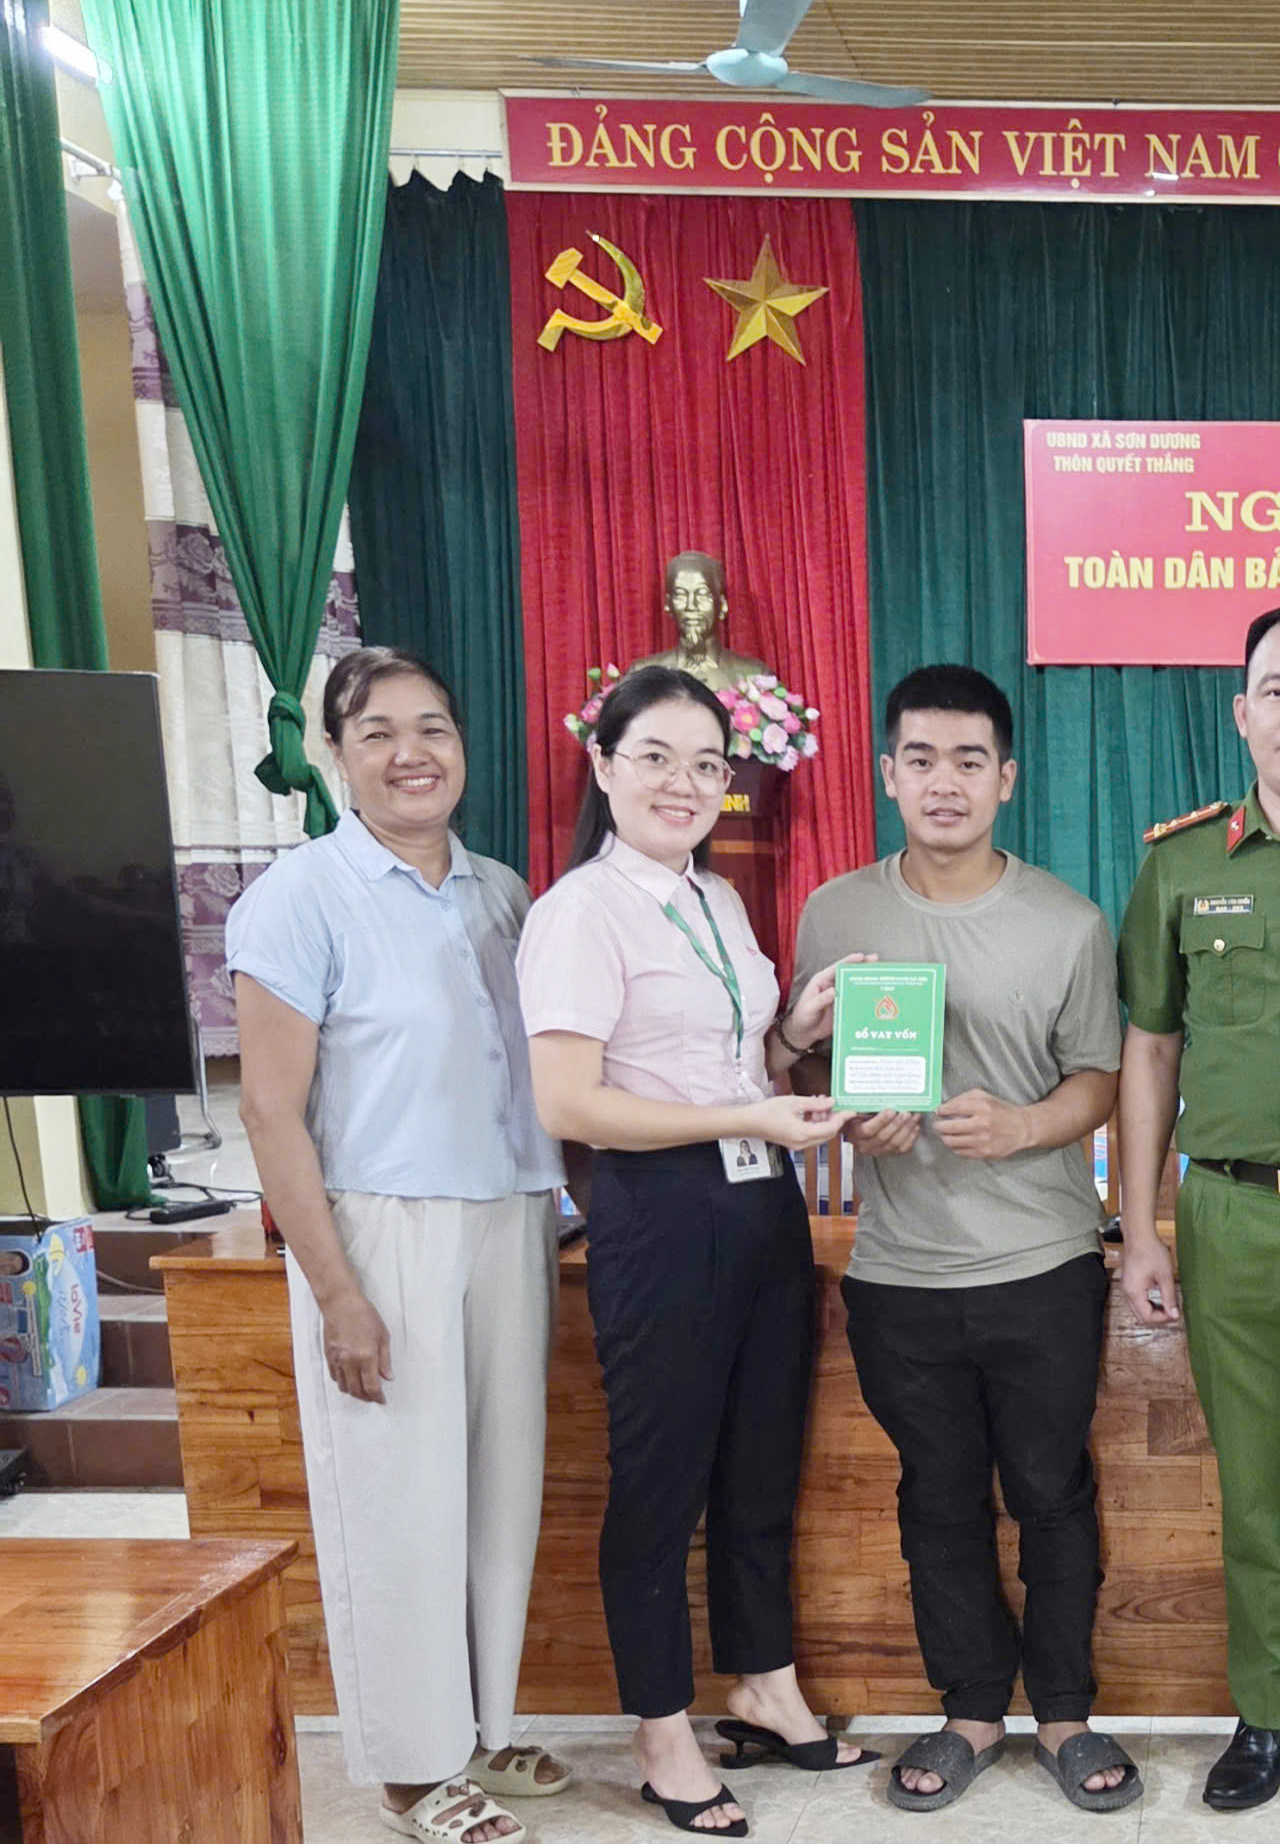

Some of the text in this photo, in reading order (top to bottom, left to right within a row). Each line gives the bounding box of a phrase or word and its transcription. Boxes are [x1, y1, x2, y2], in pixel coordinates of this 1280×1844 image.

[545, 104, 697, 169] ĐẢNG
[716, 112, 862, 184] CỘNG
[880, 111, 982, 175] SẢN
[1001, 118, 1126, 189] VIỆT
[1144, 134, 1260, 180] NAM
[1046, 432, 1087, 448] UBND
[1091, 432, 1112, 449] XÃ
[1115, 432, 1147, 449] SƠN
[1053, 452, 1195, 473] THÔN QUYẾT THẮNG
[1063, 549, 1154, 590] TOÀN
[1163, 549, 1235, 590] DÂN
